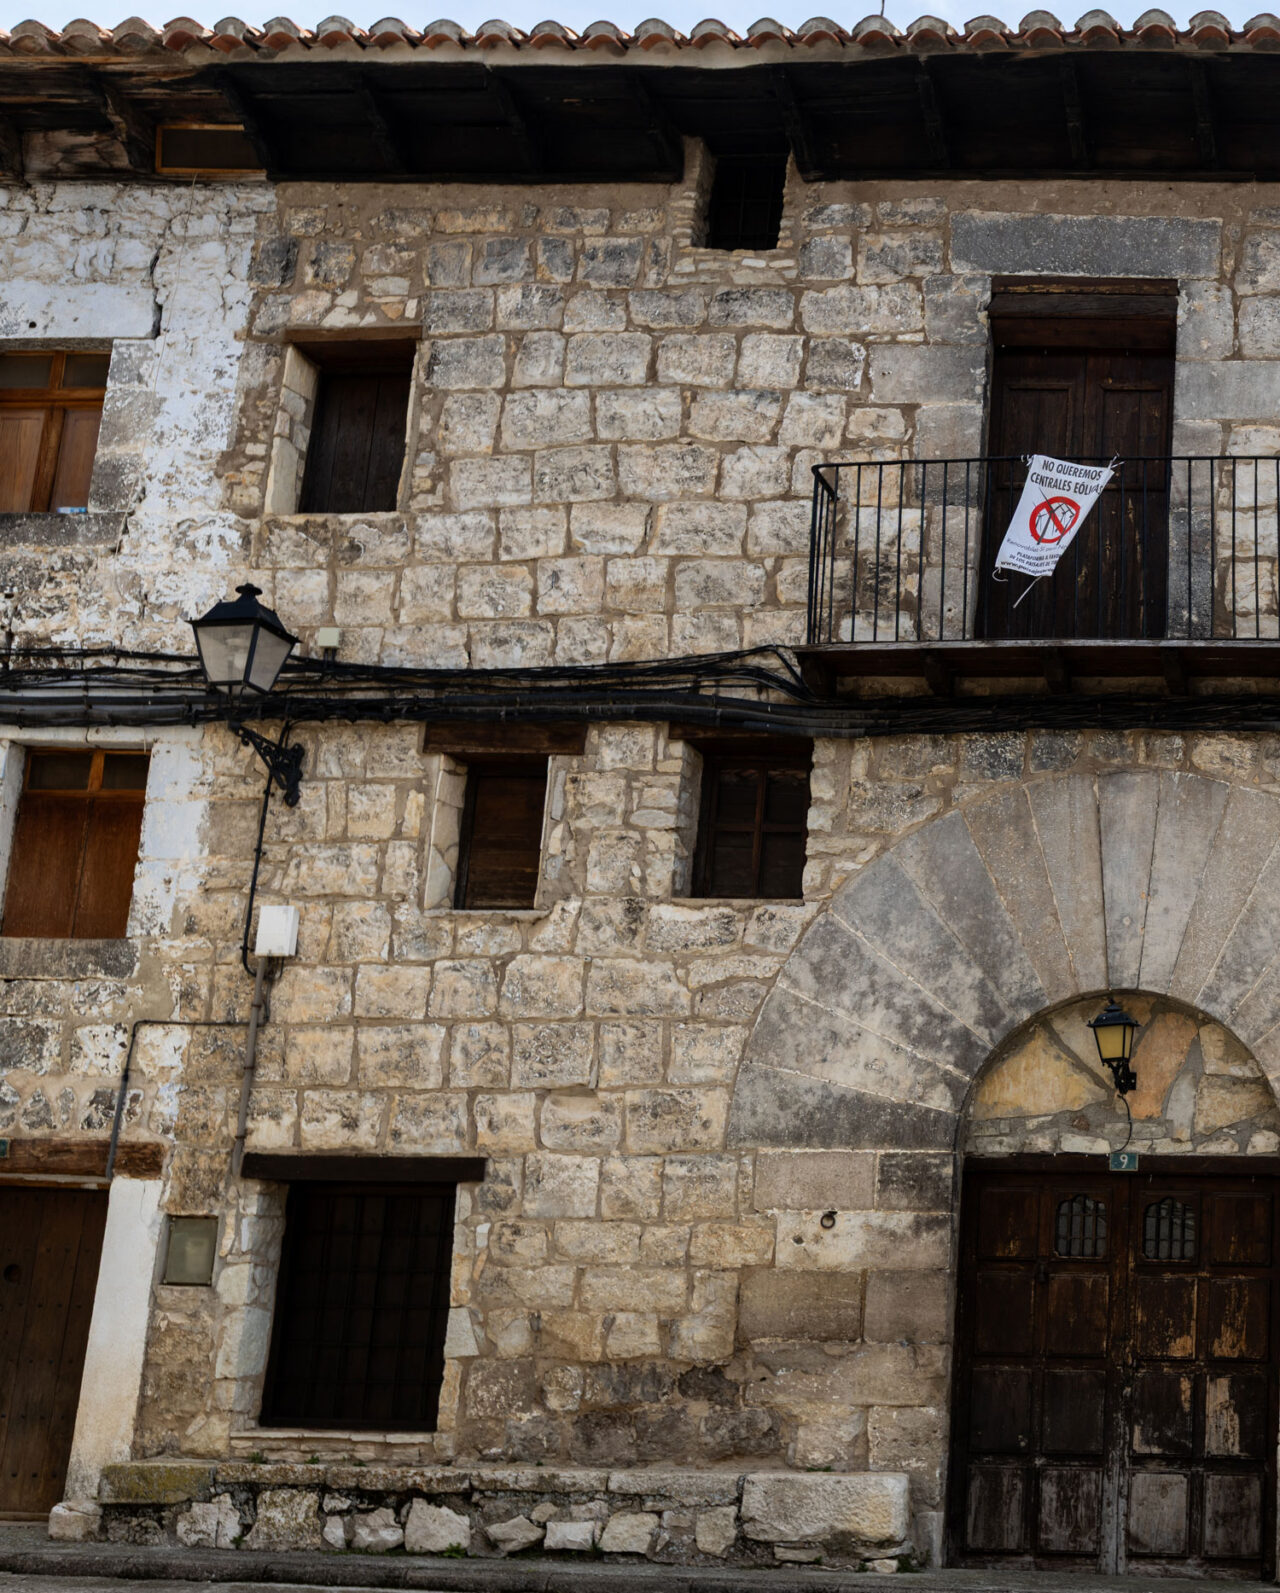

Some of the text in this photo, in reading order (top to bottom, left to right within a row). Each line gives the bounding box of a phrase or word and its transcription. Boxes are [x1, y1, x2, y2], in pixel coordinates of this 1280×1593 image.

[1042, 460, 1103, 481] NO QUEREMOS
[1030, 472, 1072, 492] CENTRALES
[1120, 1154, 1128, 1168] 9
